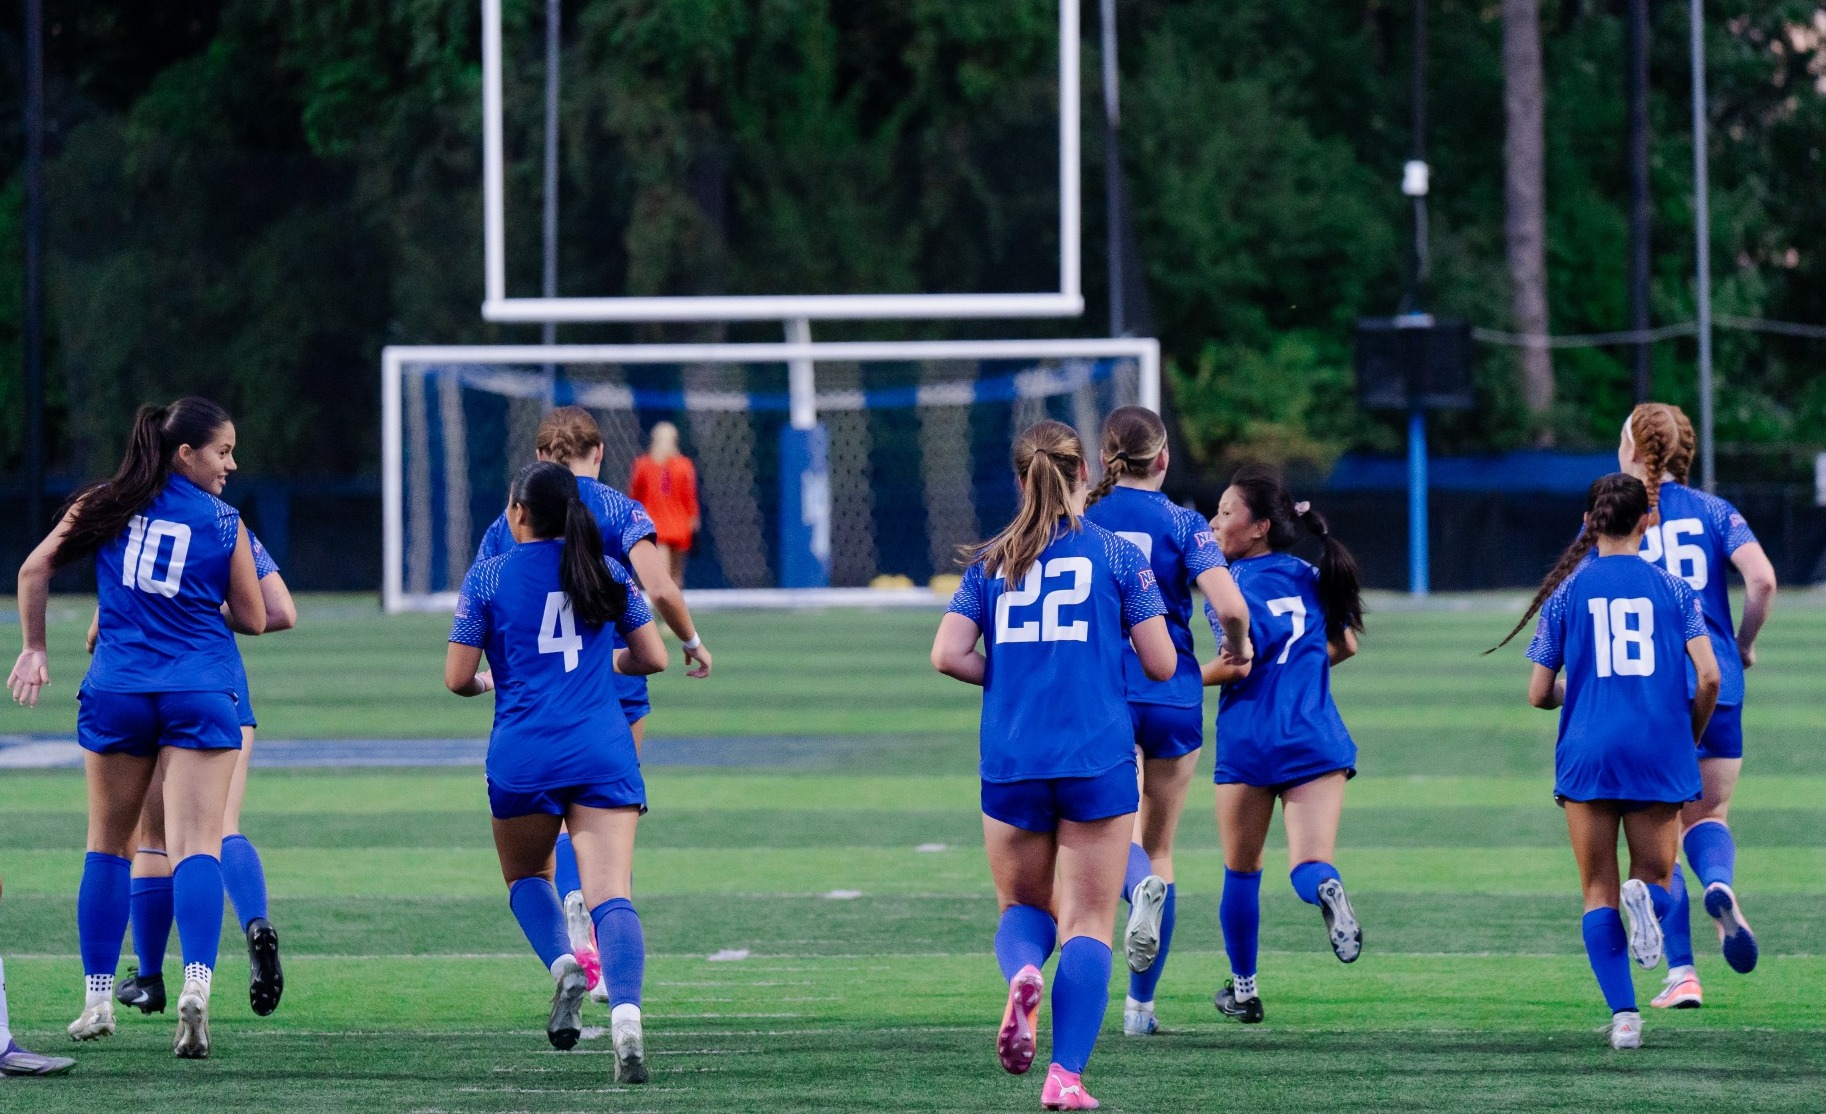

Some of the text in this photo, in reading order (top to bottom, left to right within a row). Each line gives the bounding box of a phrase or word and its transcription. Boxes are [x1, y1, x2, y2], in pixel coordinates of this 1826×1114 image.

[122, 515, 192, 598] 10
[538, 592, 583, 673] 4
[995, 557, 1093, 643] 22
[1266, 596, 1307, 664] 7
[1588, 597, 1655, 678] 18
